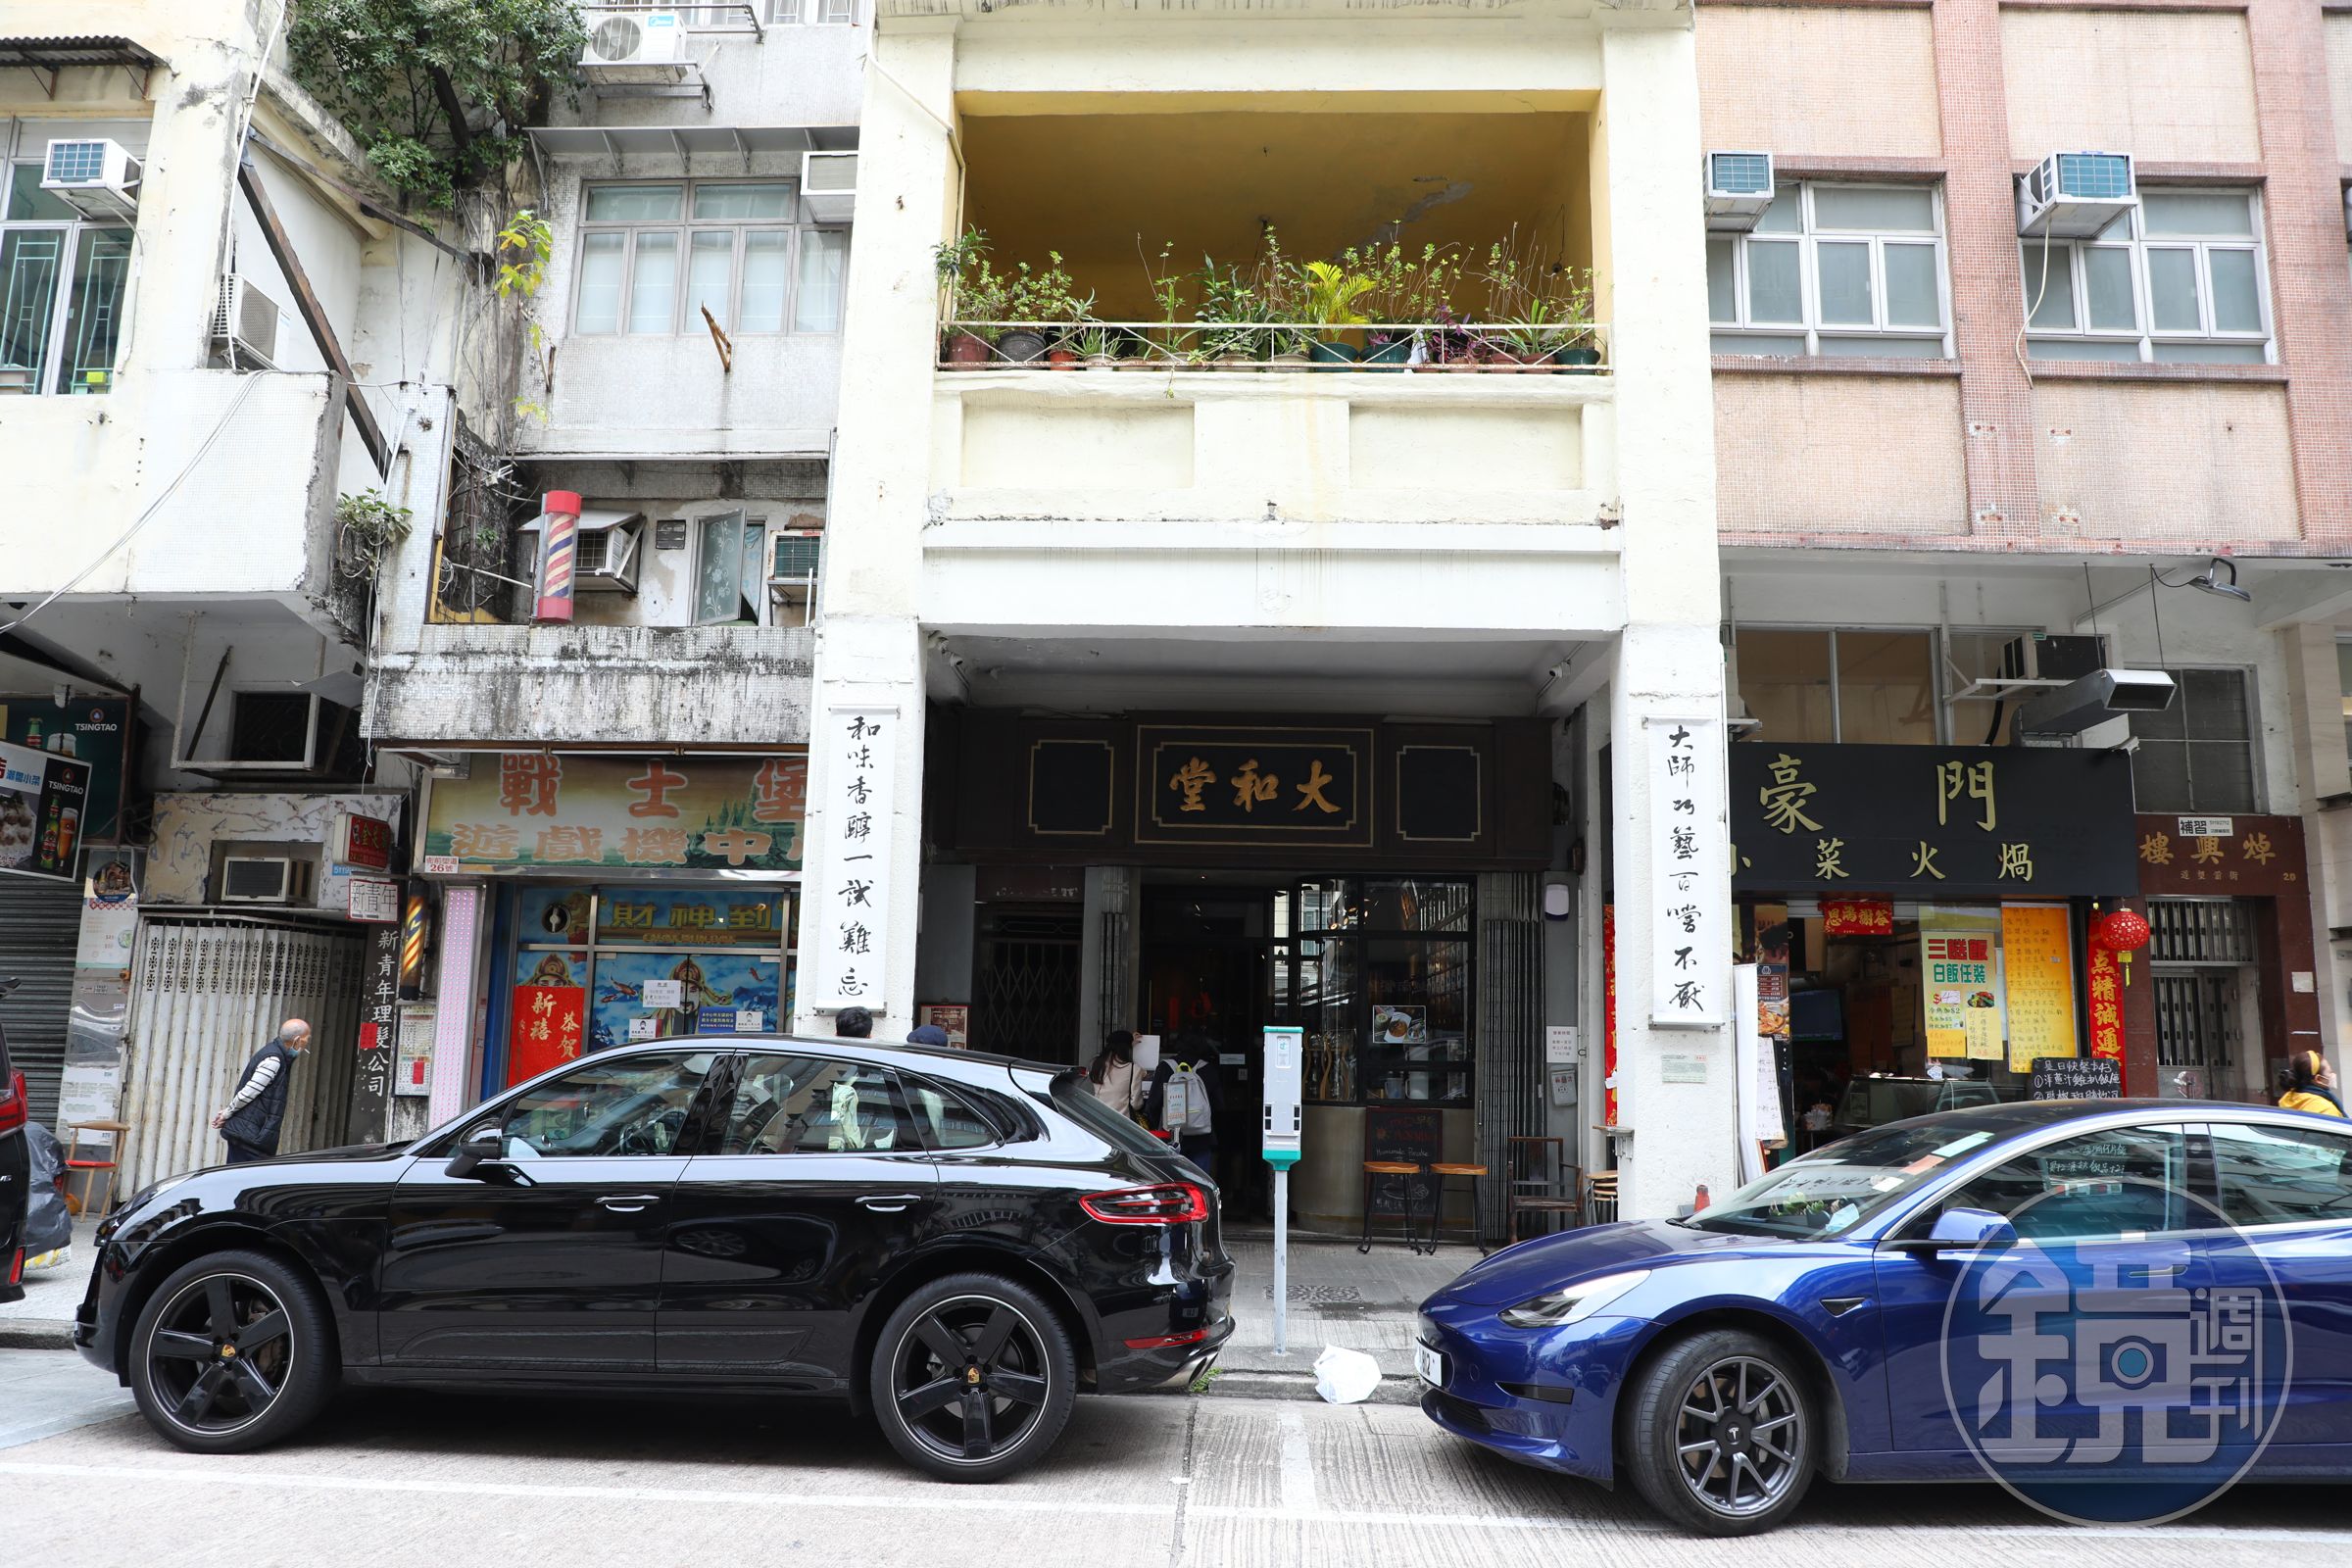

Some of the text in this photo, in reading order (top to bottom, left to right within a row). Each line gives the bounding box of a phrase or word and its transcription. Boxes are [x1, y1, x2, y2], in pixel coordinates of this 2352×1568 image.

[74, 723, 118, 732] TSINGTAO
[48, 780, 84, 795] TSINGTAO
[500, 754, 808, 823] 戰士堡
[1759, 753, 1997, 835] 豪門
[448, 823, 806, 866] 遊戲機中
[2180, 819, 2207, 835] 補習
[838, 716, 880, 997] 和味香醇一試難忘
[2283, 872, 2296, 881] 20
[352, 882, 398, 913] 新青年
[612, 902, 771, 929] 財神到
[1934, 963, 1985, 983] 白飯任裝
[368, 930, 399, 1097] 新青年理髮公司
[530, 991, 557, 1041] 新禧
[2089, 933, 2123, 1067] 一点精誠通
